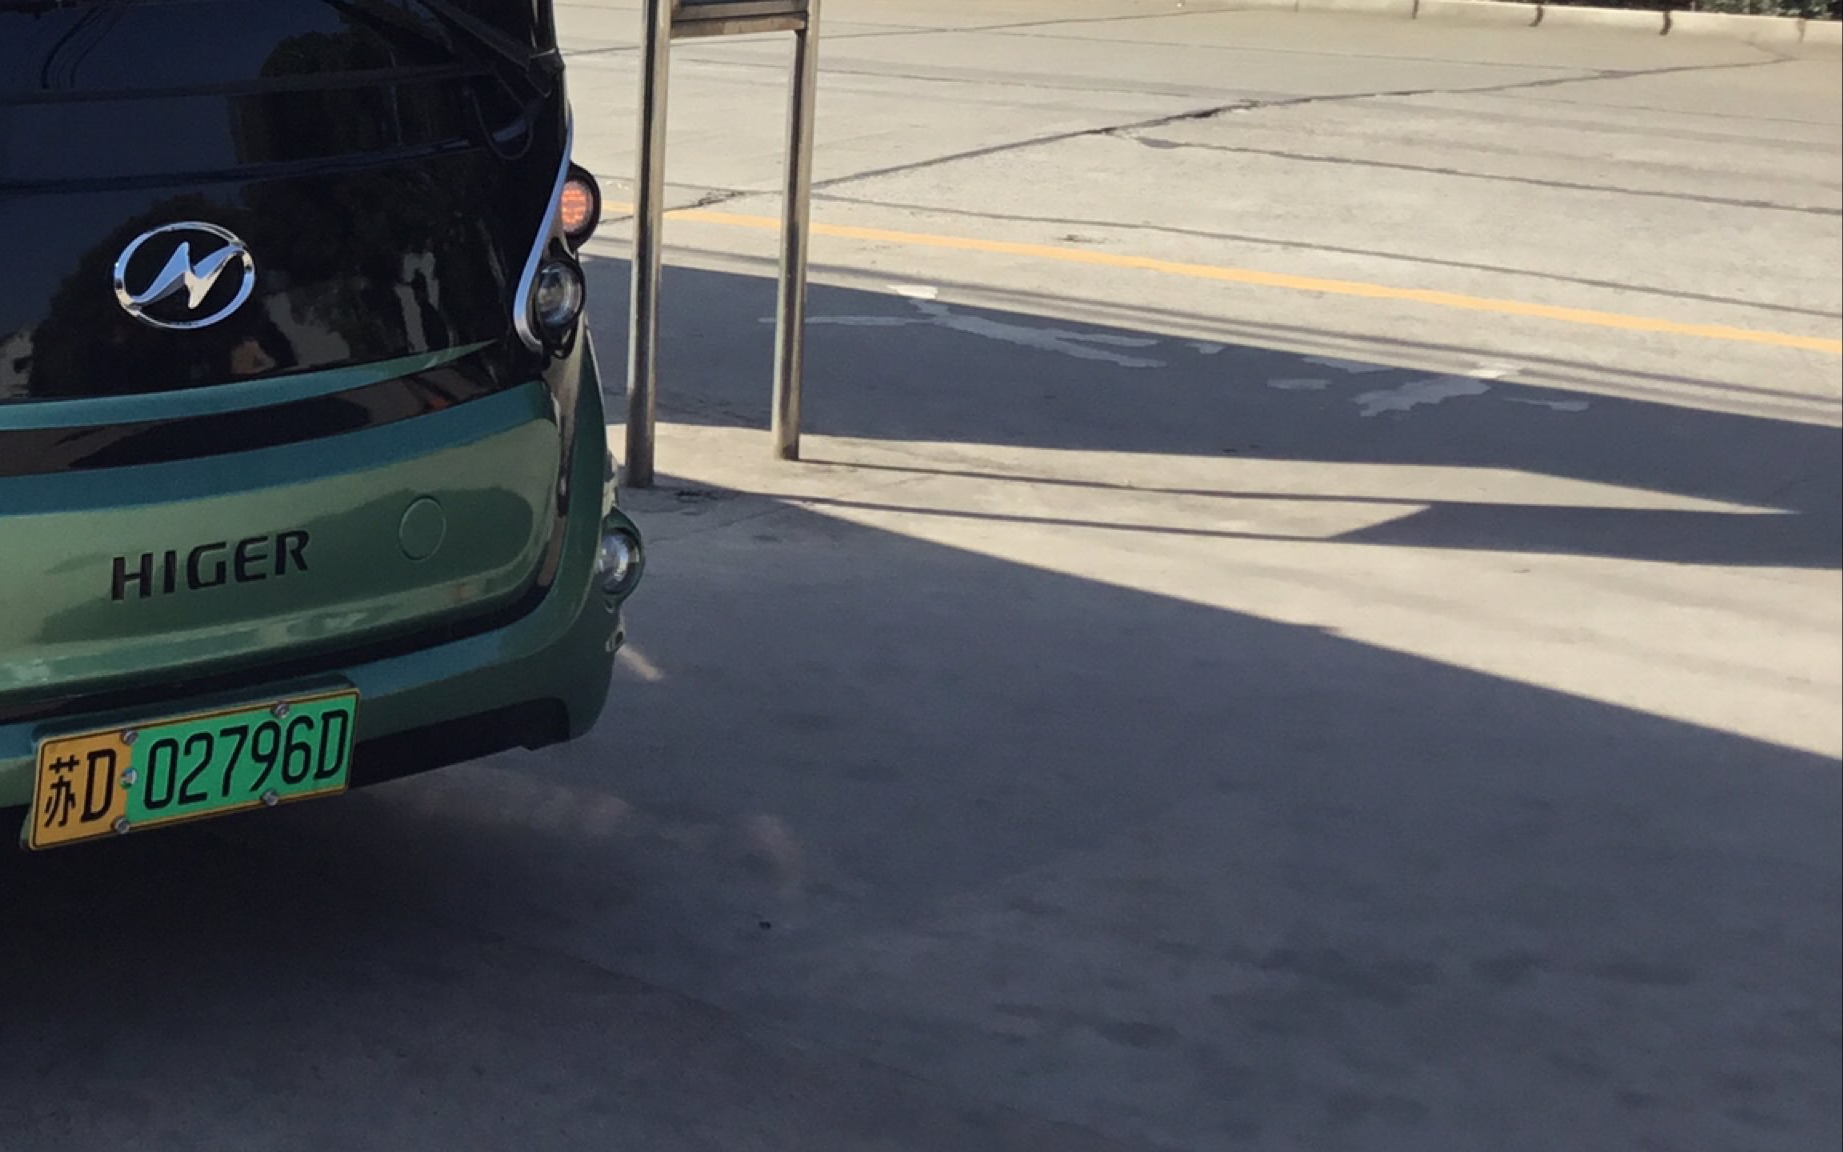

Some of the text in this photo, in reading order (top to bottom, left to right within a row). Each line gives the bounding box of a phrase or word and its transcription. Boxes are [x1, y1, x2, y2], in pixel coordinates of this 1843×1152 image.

[111, 530, 310, 600] HIGER
[44, 709, 349, 828] 苏D 02796D
